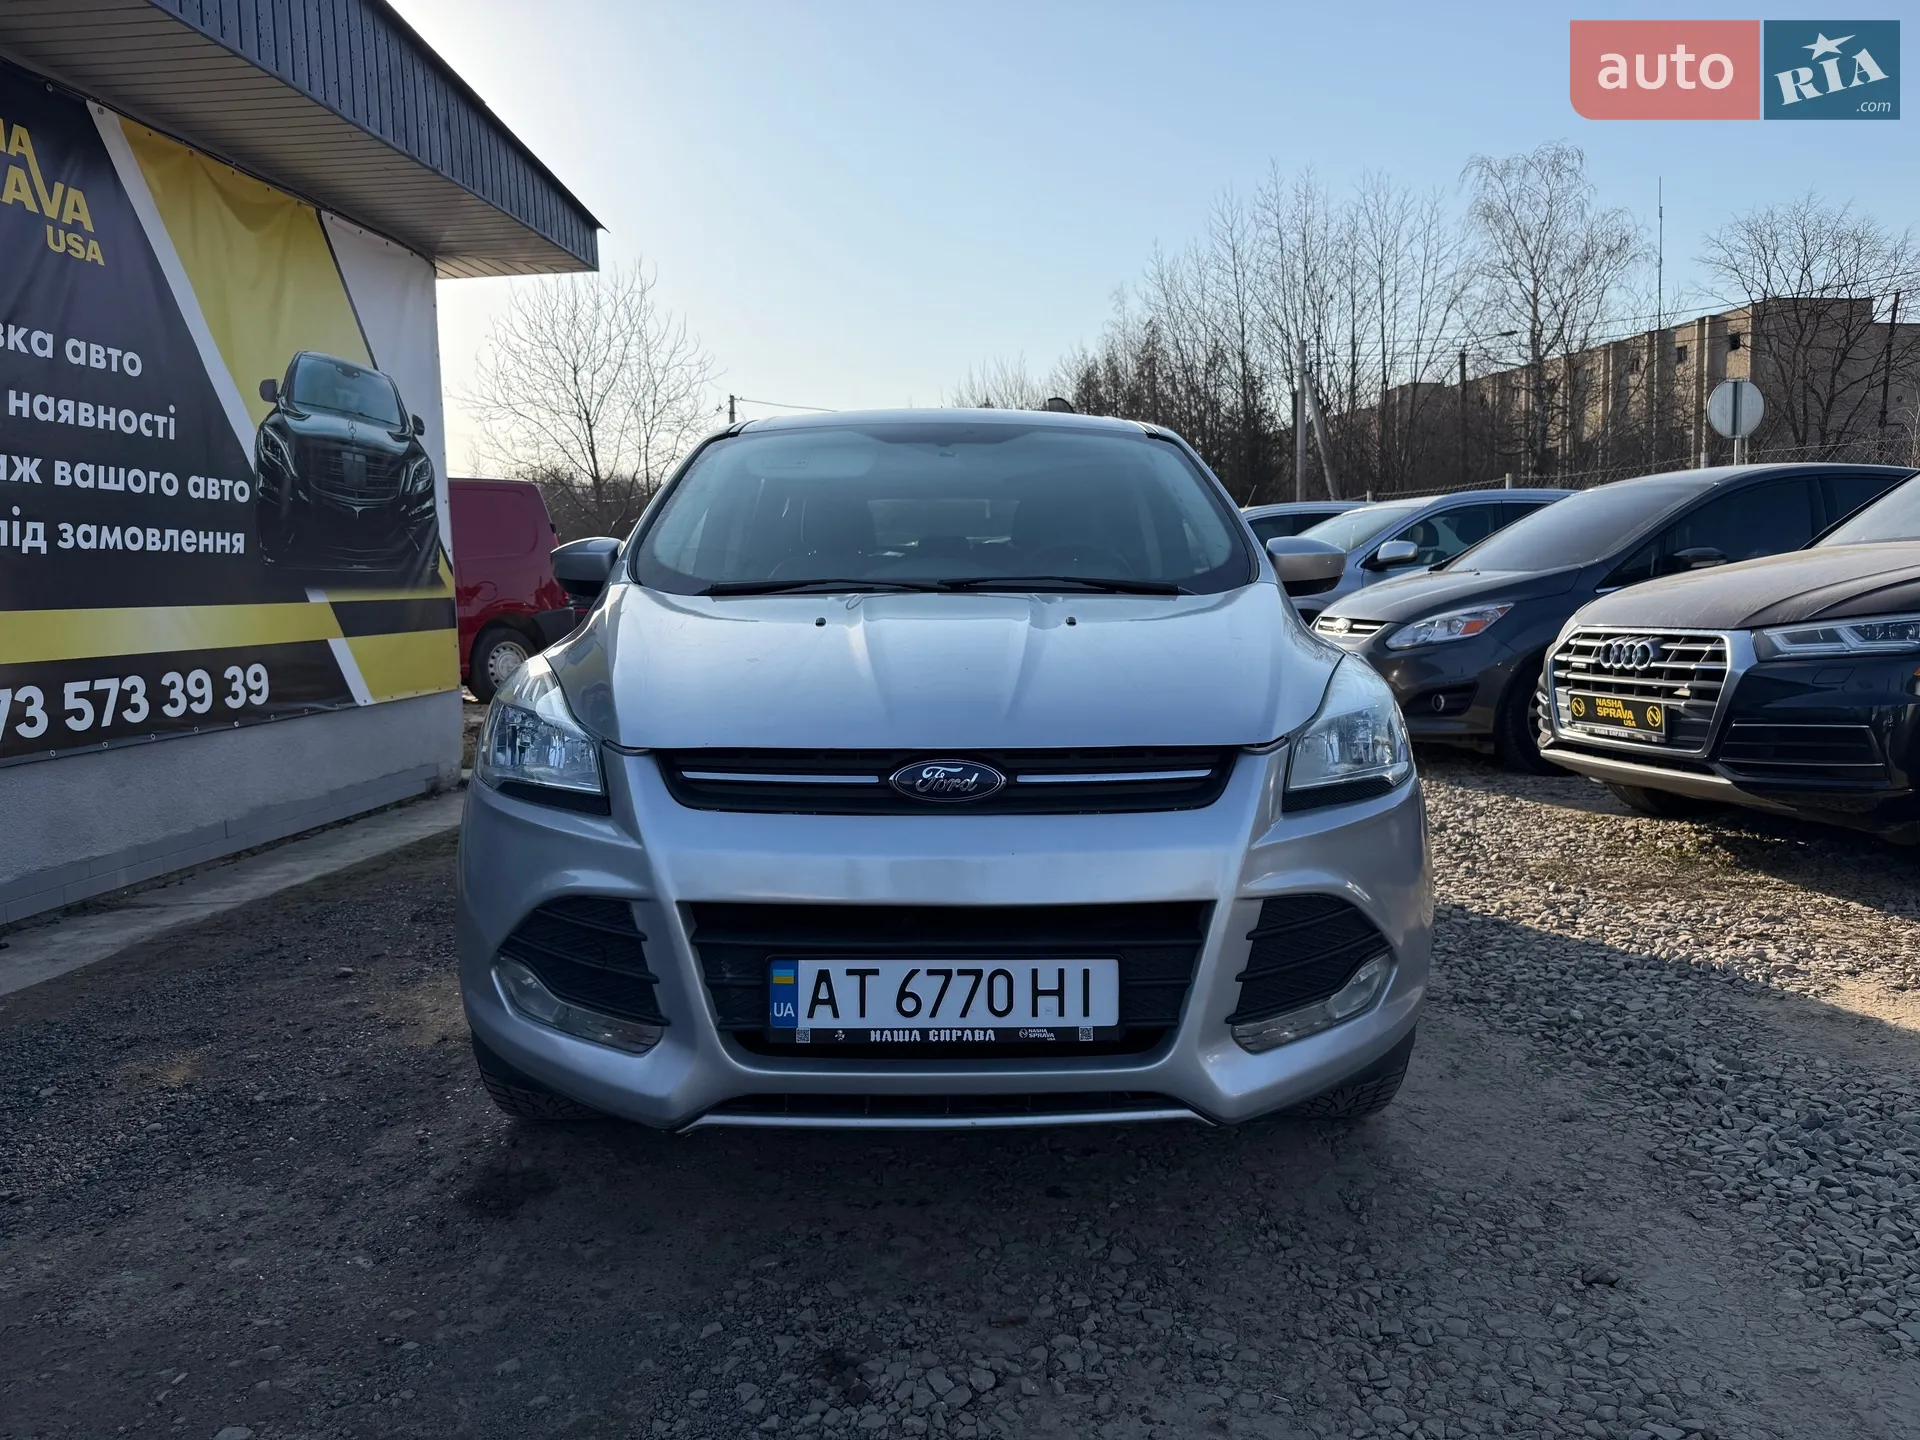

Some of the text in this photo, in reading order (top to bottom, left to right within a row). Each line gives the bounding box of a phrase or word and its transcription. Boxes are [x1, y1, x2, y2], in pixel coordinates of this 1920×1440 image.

[46, 224, 105, 266] USA
[0, 322, 142, 377] ка авто
[8, 389, 175, 440] наявності
[54, 460, 179, 497] вашого
[187, 475, 250, 503] авто
[57, 522, 245, 554] замовлення
[64, 675, 150, 732] 573
[161, 668, 213, 718] 39
[223, 663, 269, 709] 39
[1596, 699, 1623, 708] NASHA
[1597, 707, 1634, 719] SPRAVA
[915, 766, 979, 792] Ford
[773, 1002, 795, 1018] UA
[806, 967, 1090, 1019] AT 6770 HI
[870, 1029, 996, 1042] НАША СПРАВА
